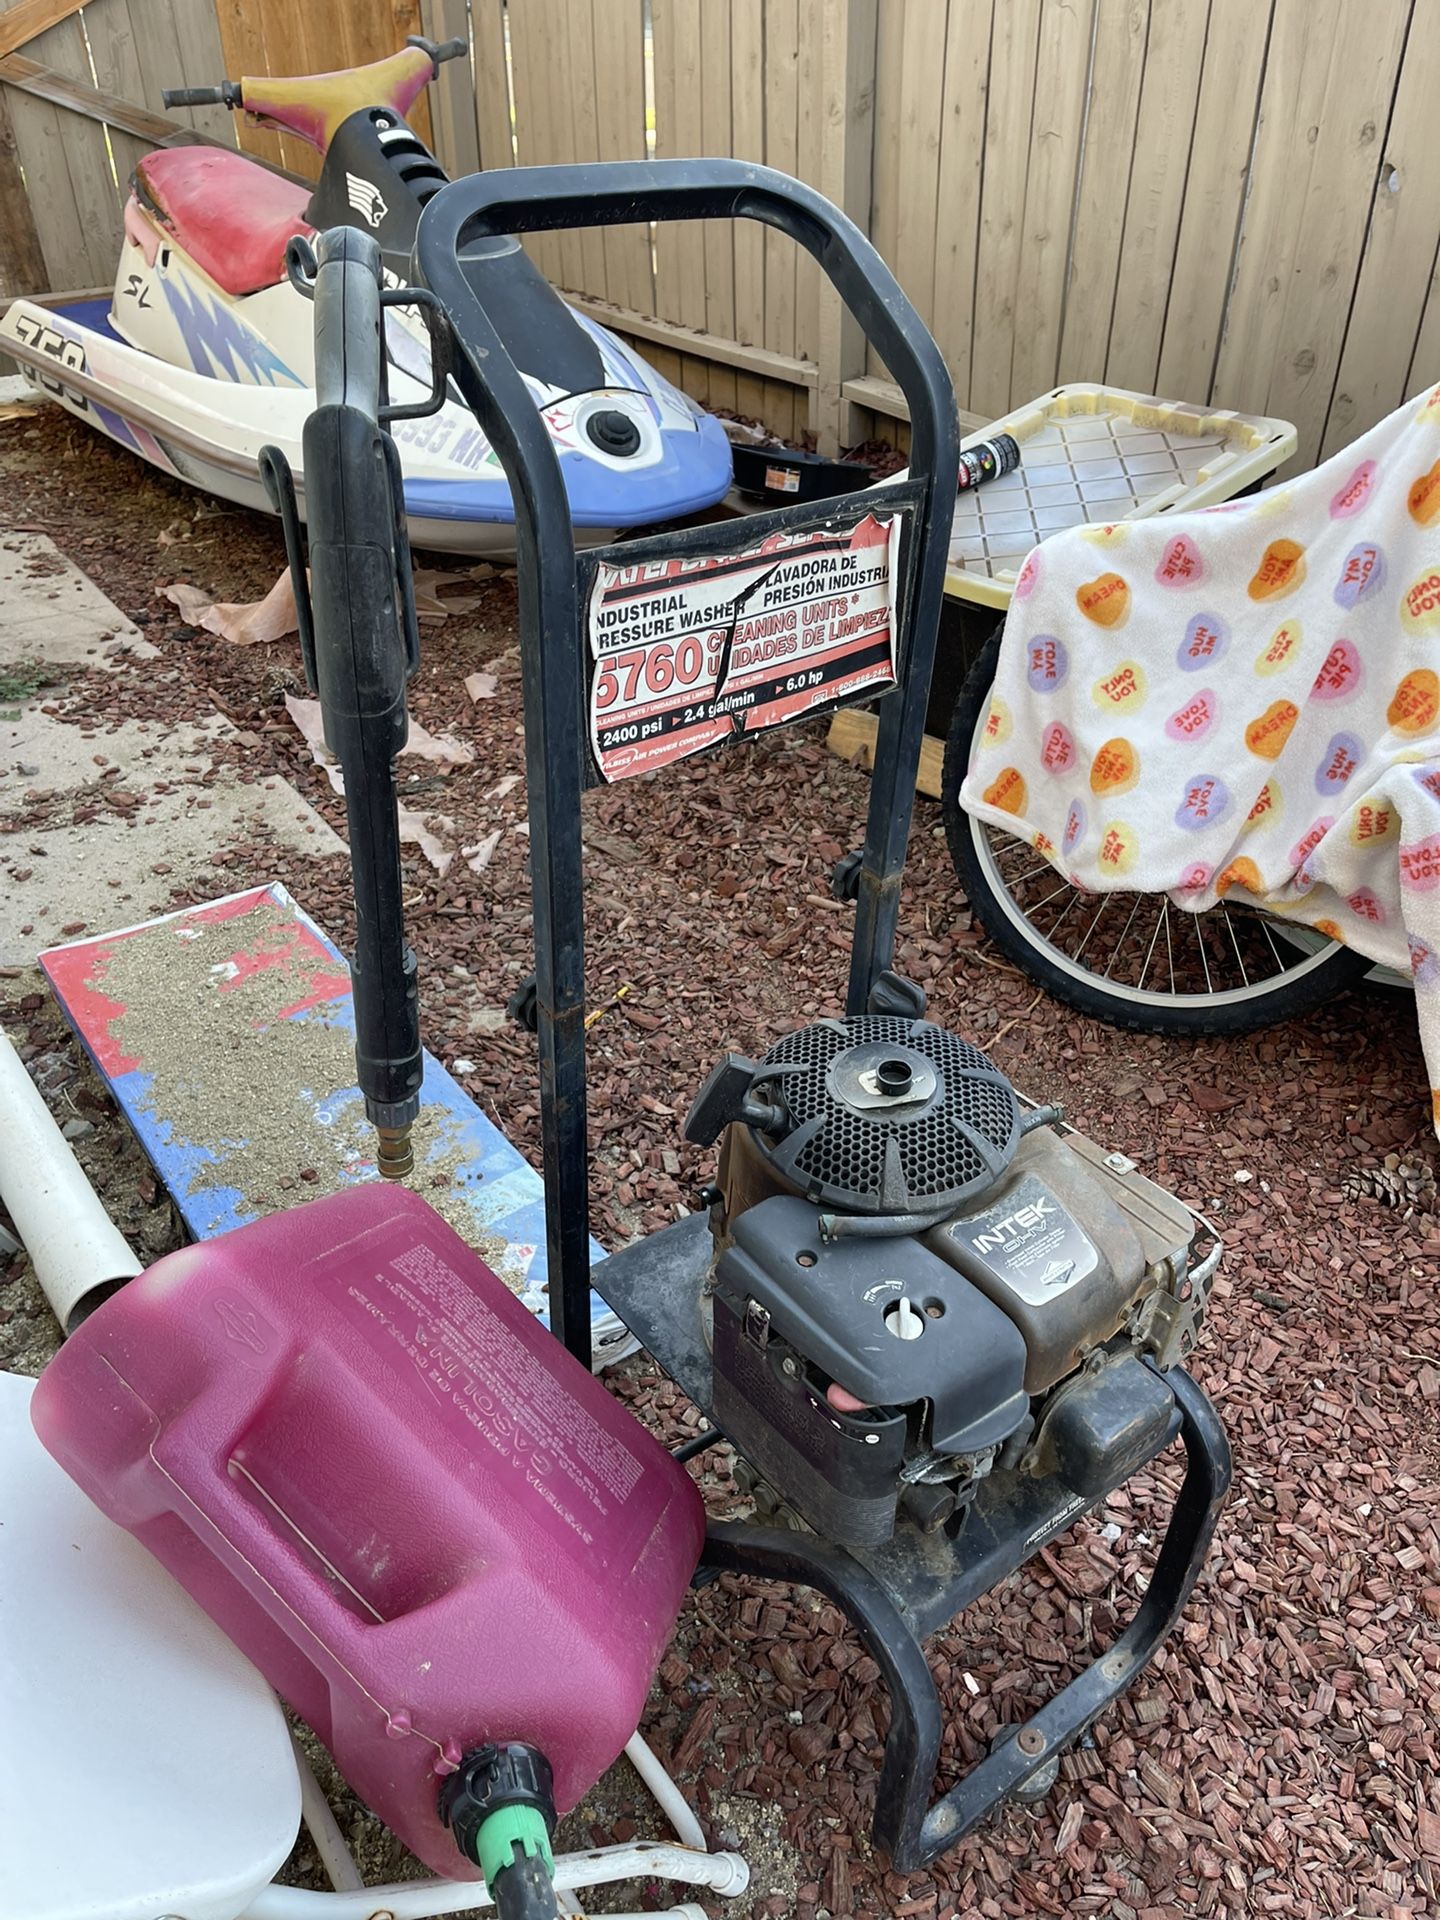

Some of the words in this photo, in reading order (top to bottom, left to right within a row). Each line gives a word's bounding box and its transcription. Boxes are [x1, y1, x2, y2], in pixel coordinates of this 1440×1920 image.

[763, 576, 825, 608] PRESIÓN
[765, 557, 837, 588] LAVADORA
[840, 554, 858, 571] DE
[596, 616, 675, 649] RESSURE
[680, 600, 746, 629] WASHER
[597, 594, 688, 629] NDUSTRIAL
[801, 596, 849, 626] UNITS
[707, 632, 798, 677] UIDADES
[801, 624, 826, 649] DE
[597, 636, 703, 709] 5760
[603, 725, 638, 747] 2400
[641, 716, 662, 739] psi
[683, 704, 705, 723] 2.4
[708, 690, 755, 718] gal/min
[785, 674, 806, 692] 6.0
[808, 670, 824, 685] hp
[648, 741, 678, 757] POWER
[971, 1196, 1058, 1255] INTEK
[1002, 1219, 1047, 1254] OHV
[407, 1322, 555, 1478] GASOLINA
